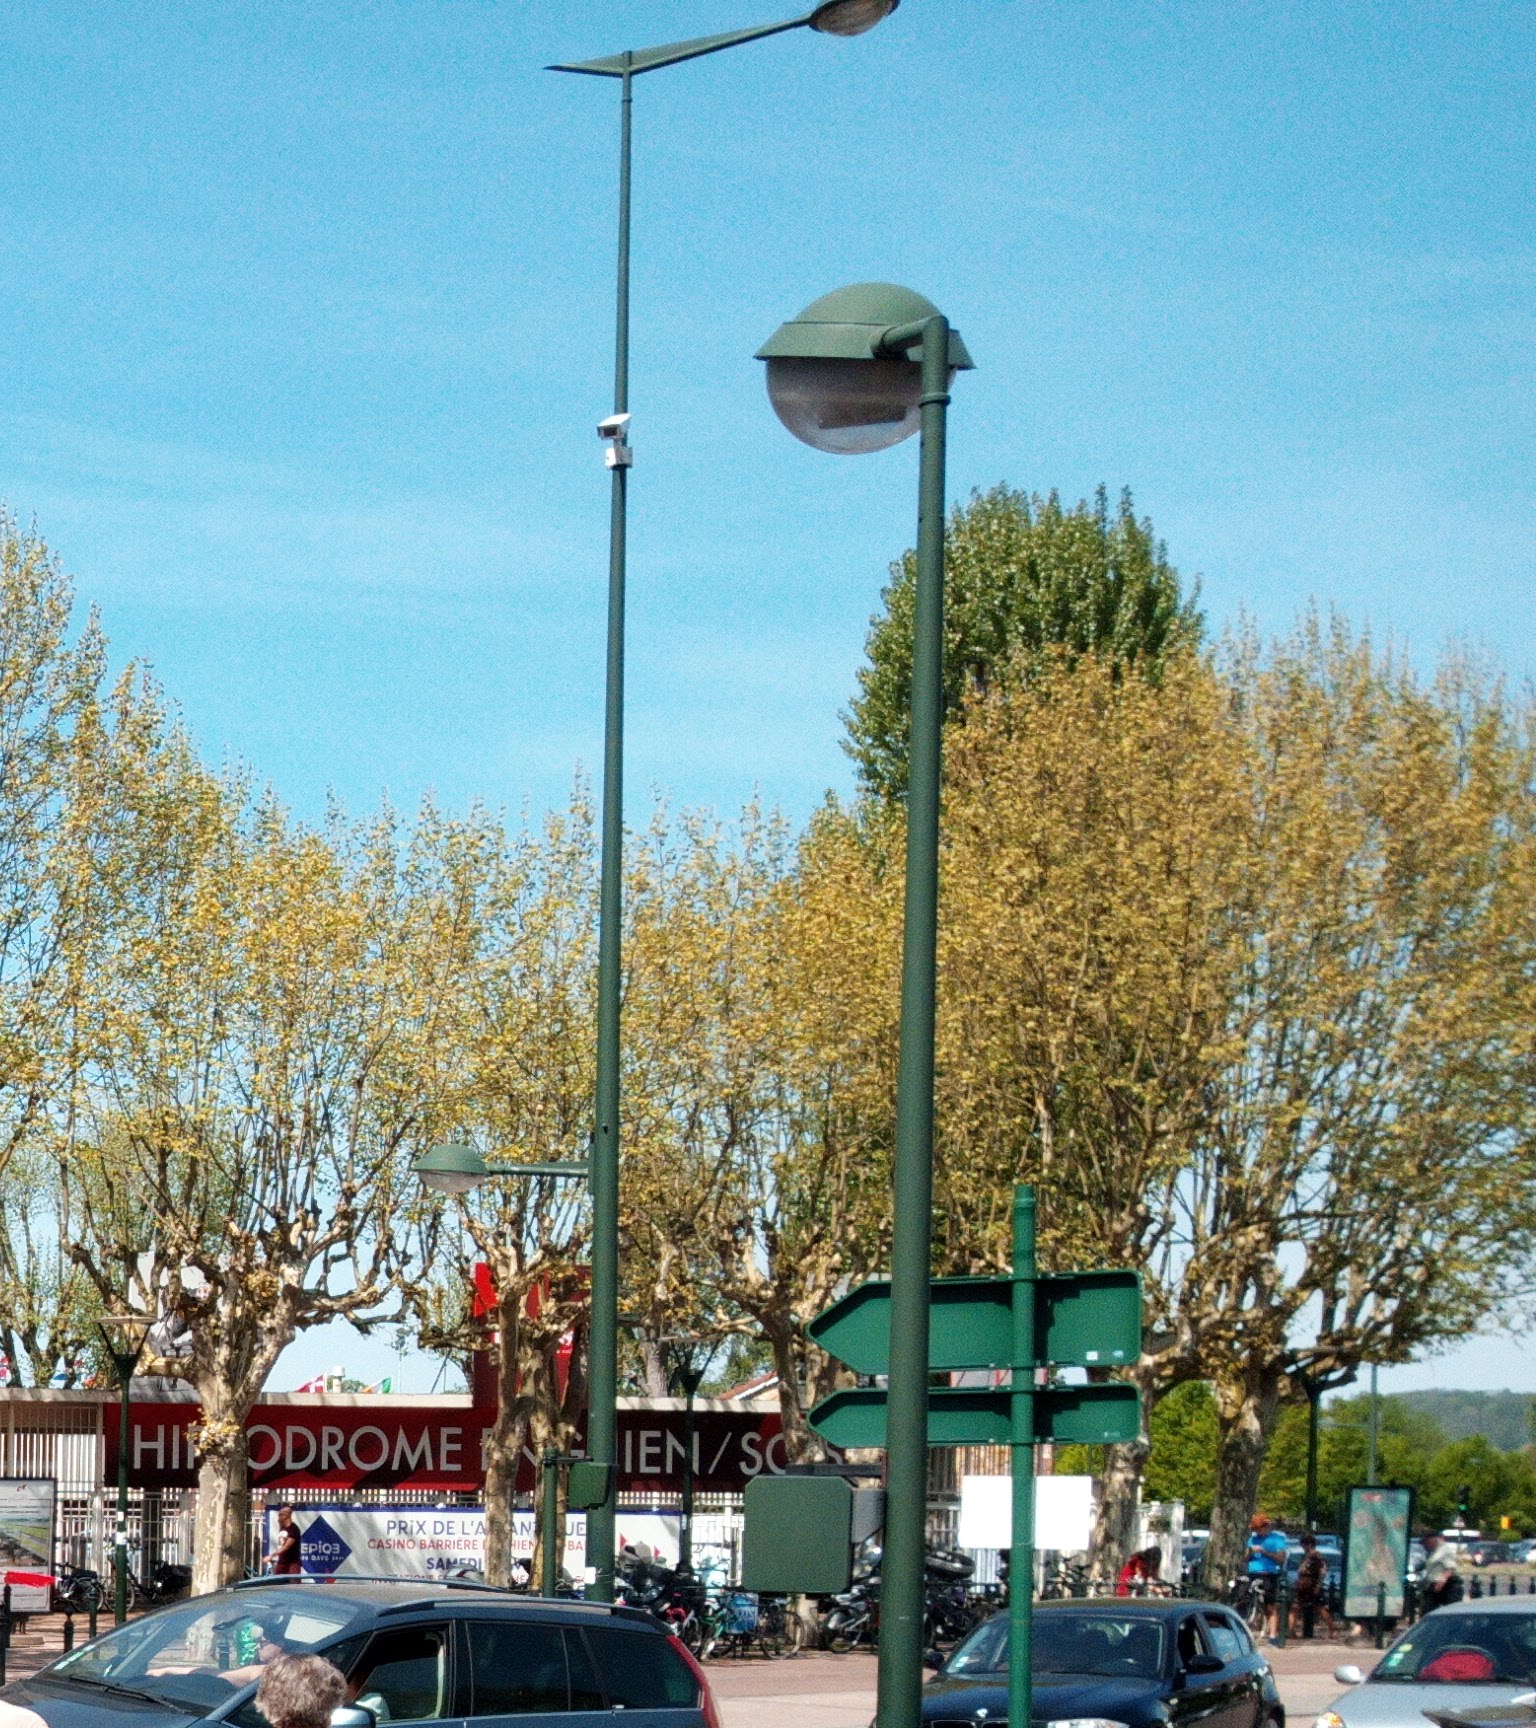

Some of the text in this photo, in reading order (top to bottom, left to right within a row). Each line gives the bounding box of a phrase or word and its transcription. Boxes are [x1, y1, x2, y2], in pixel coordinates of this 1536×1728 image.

[433, 1520, 456, 1536] DE
[367, 1538, 415, 1550] CASINO
[419, 1537, 478, 1550] BARRIÈRE
